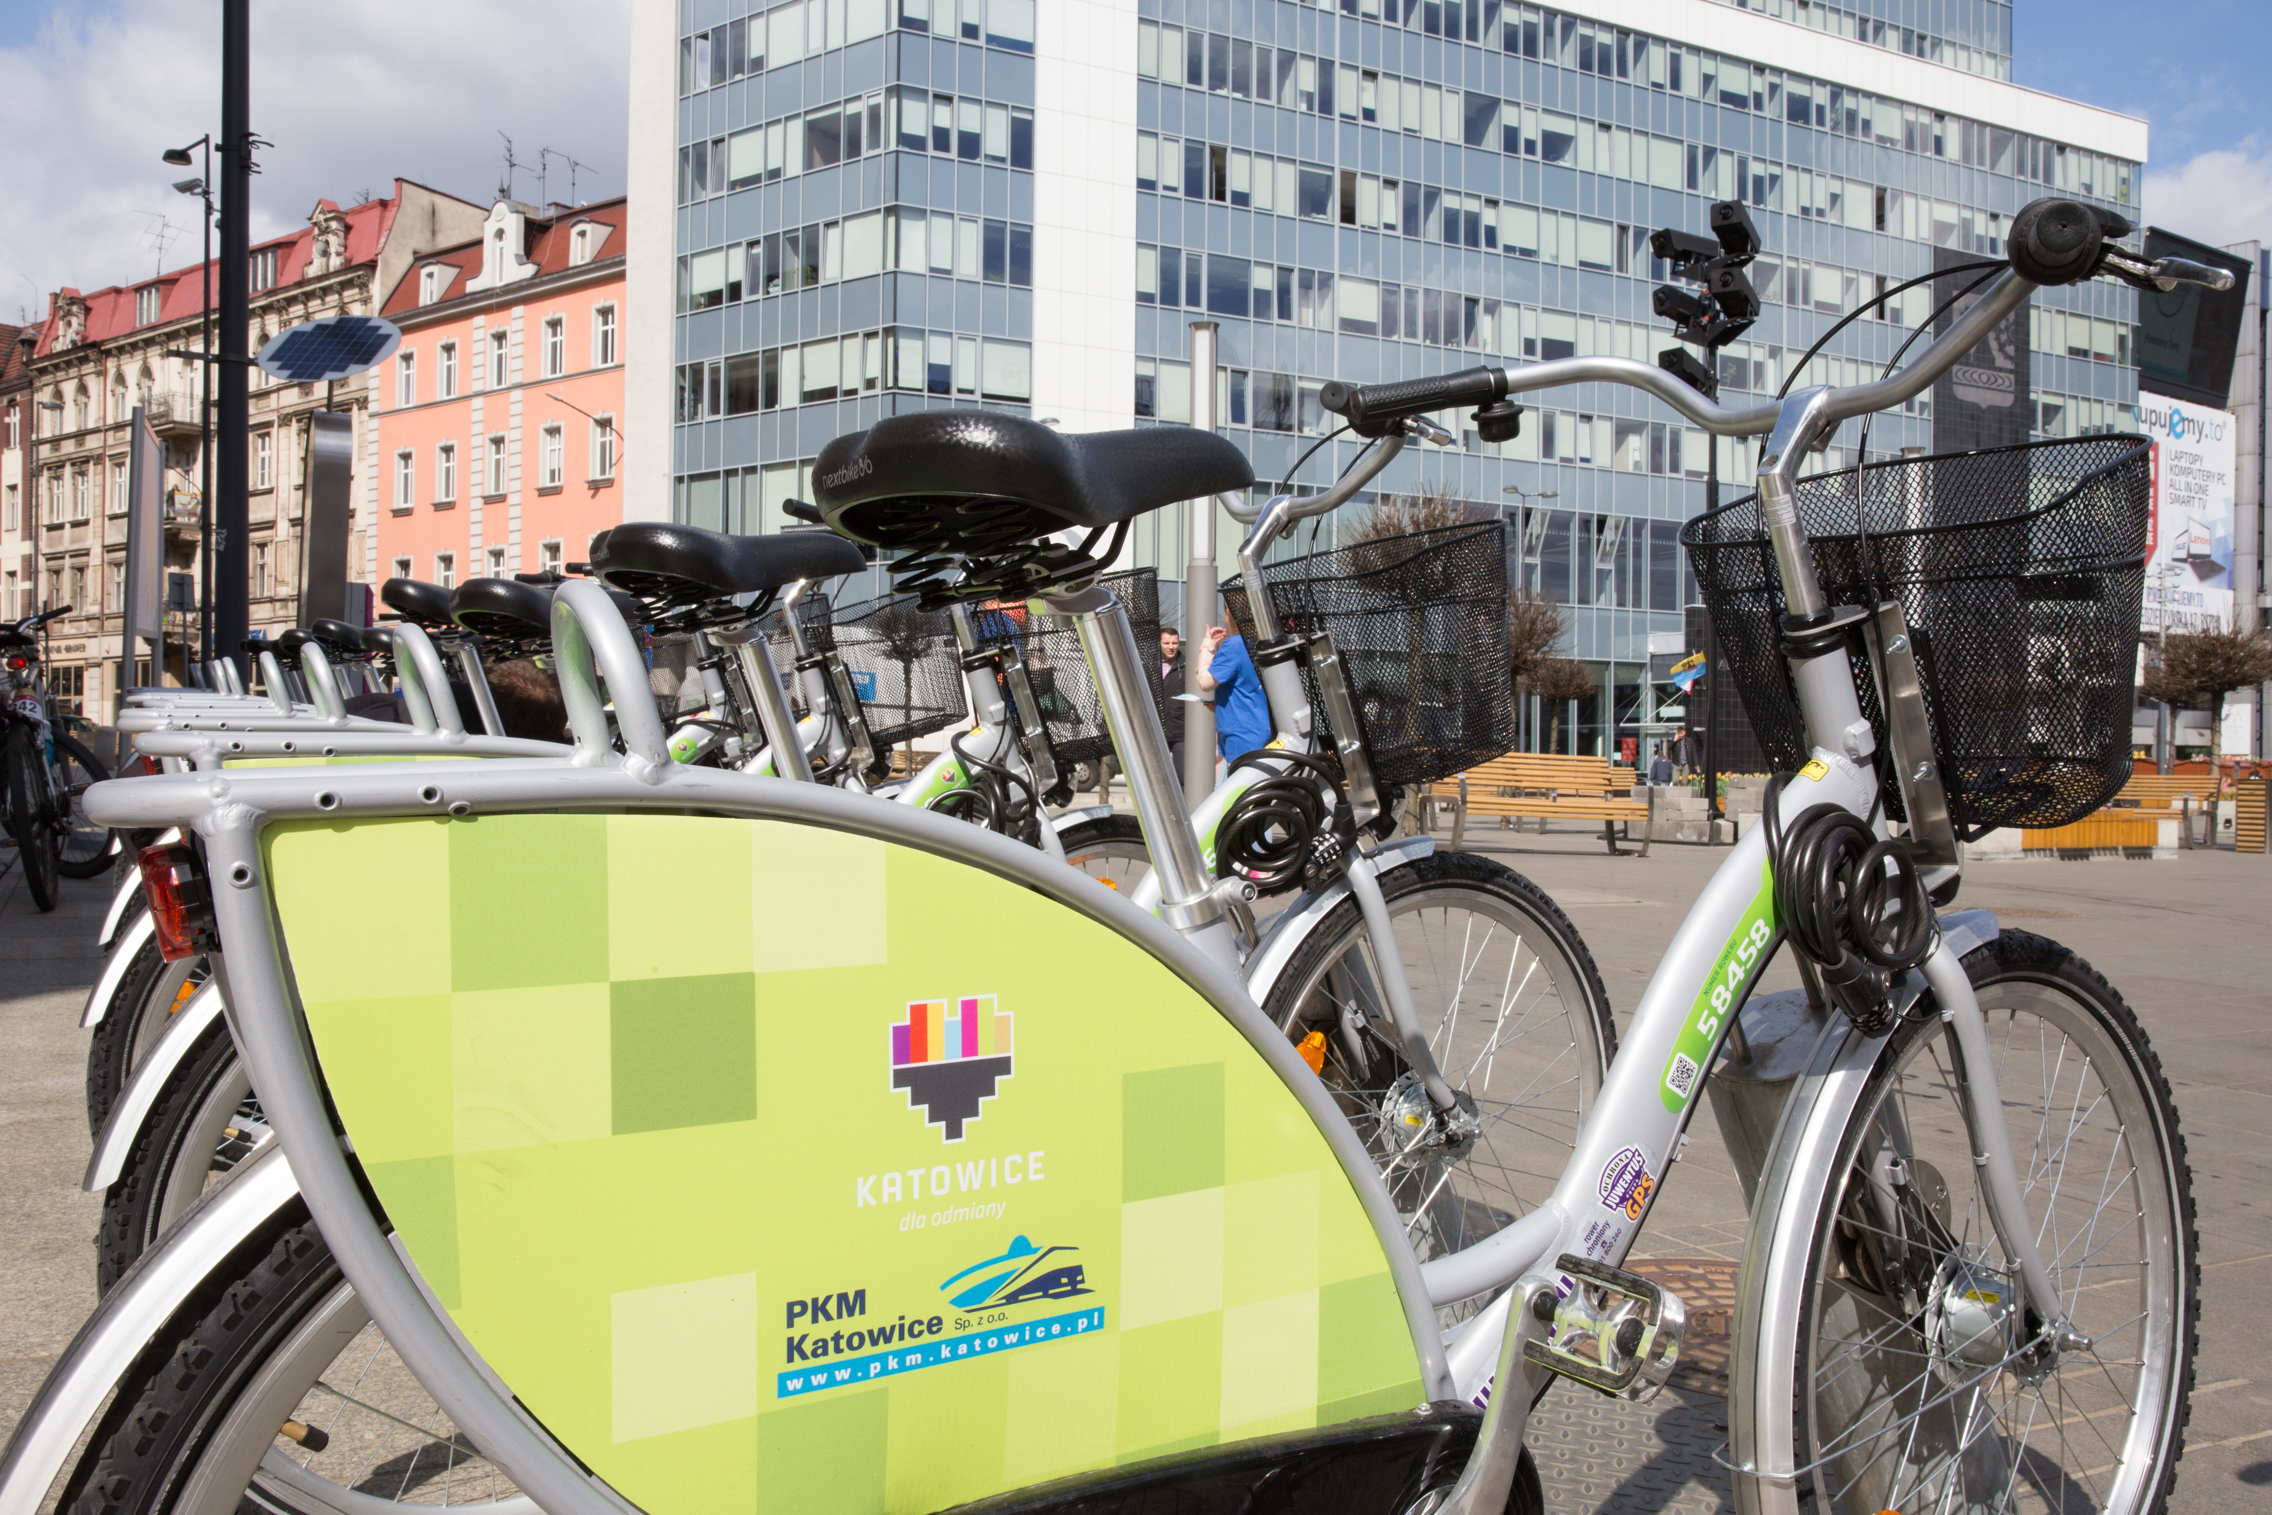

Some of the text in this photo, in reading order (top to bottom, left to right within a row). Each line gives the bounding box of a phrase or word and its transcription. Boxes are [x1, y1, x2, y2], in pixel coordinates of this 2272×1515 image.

[822, 461, 859, 490] nextbike
[2169, 448, 2204, 467] LAPTOPY
[2169, 463, 2227, 486] KOMPUTERY PC
[2169, 478, 2210, 497] ALL IN ONE
[2169, 492, 2208, 511] SMART TV
[2189, 531, 2211, 546] Lenovo
[1696, 918, 1771, 1041] 58458
[1703, 938, 1738, 997] NUMER ROWERU
[856, 1150, 1046, 1208] KATOWICE
[1602, 1153, 1630, 1193] OCHRONA
[1604, 1151, 1644, 1209] JUWENTUS
[1625, 1173, 1655, 1221] GPS
[898, 1201, 1006, 1232] dla odmiany
[1583, 1221, 1600, 1244] rower
[1586, 1220, 1611, 1257] chroniony
[1603, 1241, 1614, 1256] 800
[1611, 1228, 1622, 1243] 260
[785, 1288, 867, 1330] PKM
[785, 1311, 1009, 1364] Katowice Sp. z o.o.
[785, 1310, 1099, 1392] www.pkm.katowice.pl
